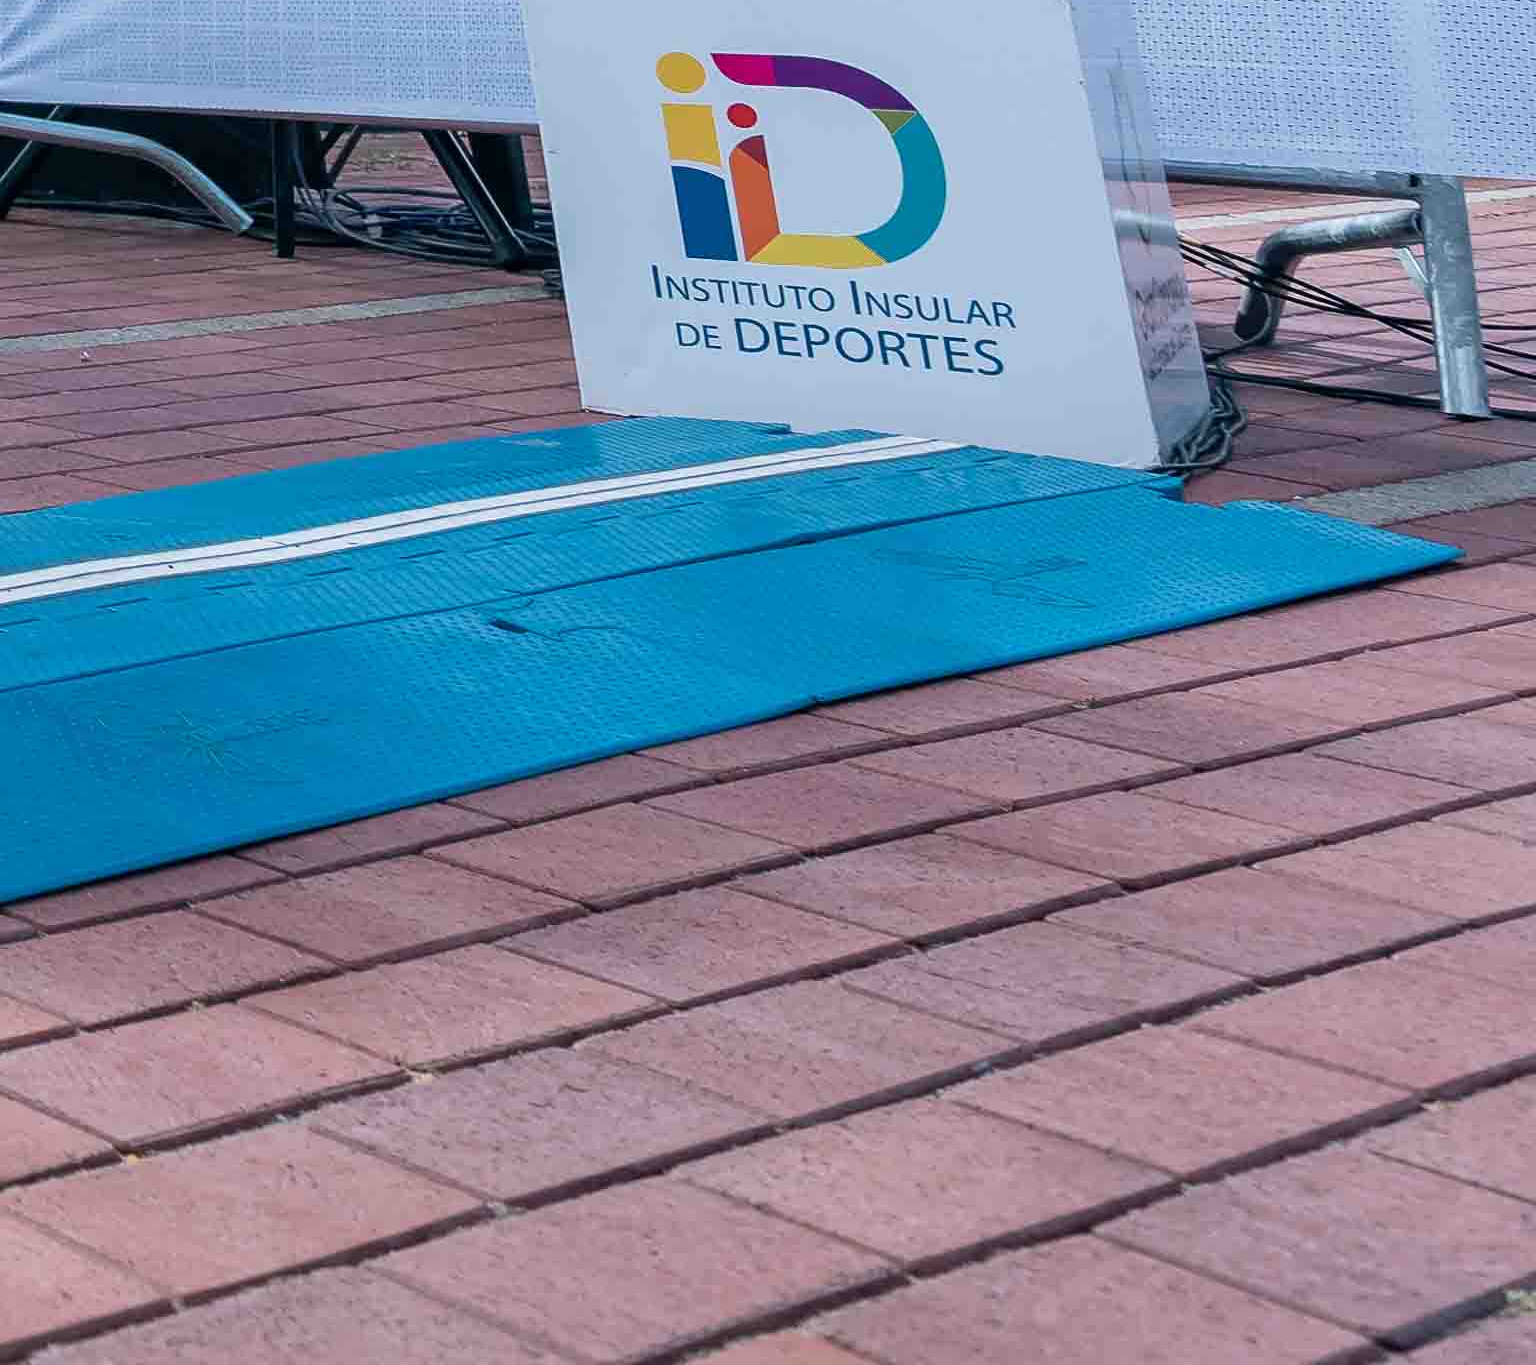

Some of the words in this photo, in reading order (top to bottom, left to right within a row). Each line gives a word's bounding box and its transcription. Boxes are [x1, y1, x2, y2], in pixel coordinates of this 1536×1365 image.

[652, 264, 835, 312] INSTITUTO
[850, 280, 1017, 328] INSULAR
[676, 322, 721, 350] DE
[735, 318, 1004, 376] DEPORTES
